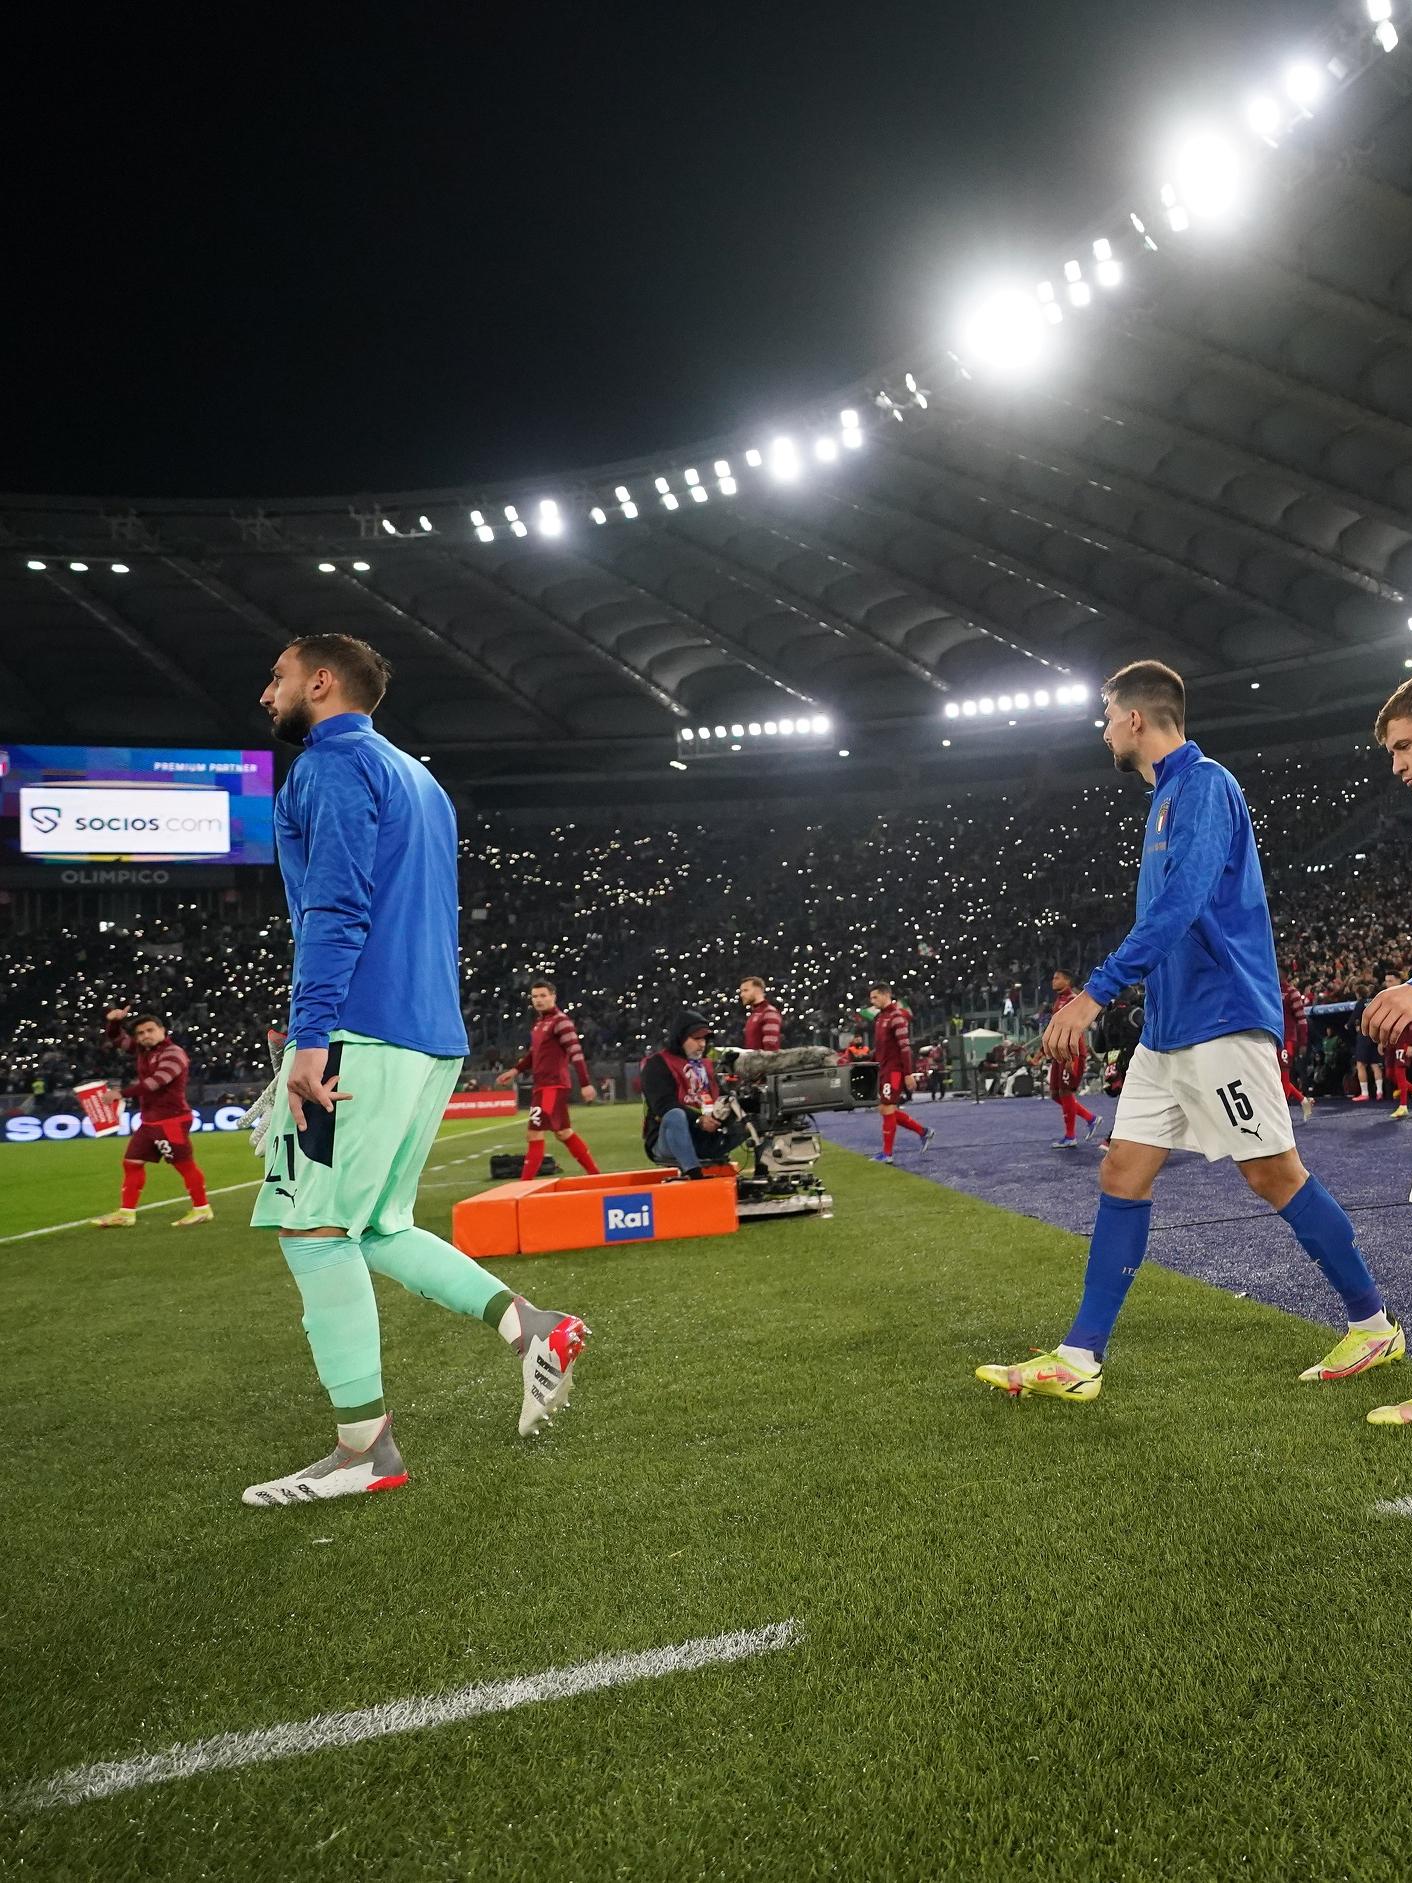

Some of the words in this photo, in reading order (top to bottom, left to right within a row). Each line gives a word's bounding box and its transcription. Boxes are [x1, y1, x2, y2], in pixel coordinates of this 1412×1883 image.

[154, 762, 206, 772] PREMIUM
[209, 763, 257, 773] PARTNER
[61, 870, 169, 884] OLIMPICO
[883, 1083, 891, 1095] 8
[1216, 1079, 1254, 1127] 15
[265, 1134, 295, 1182] 21
[608, 1204, 650, 1230] Rai
